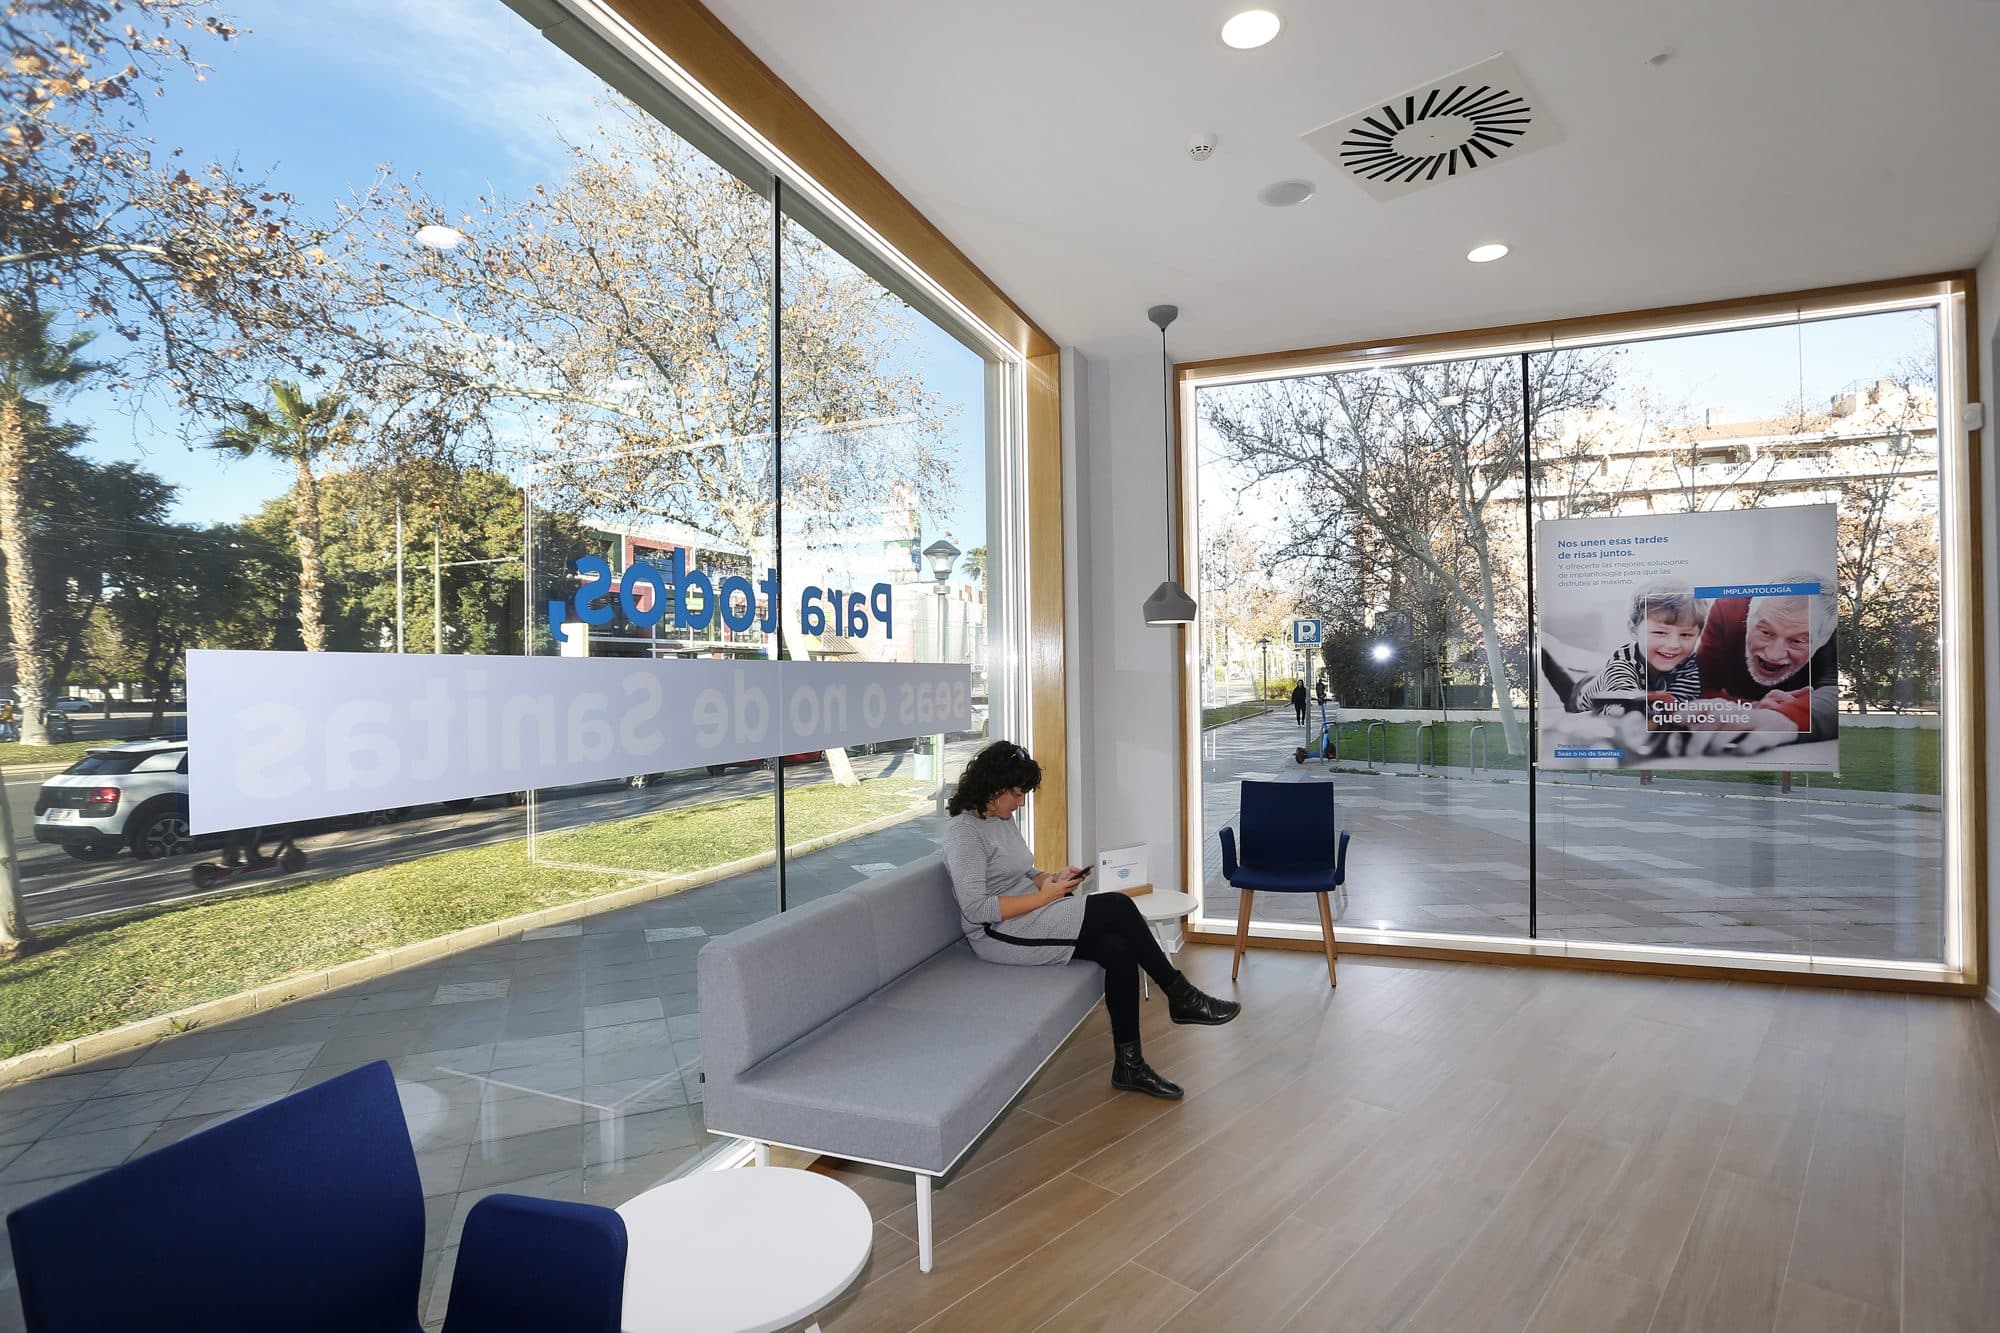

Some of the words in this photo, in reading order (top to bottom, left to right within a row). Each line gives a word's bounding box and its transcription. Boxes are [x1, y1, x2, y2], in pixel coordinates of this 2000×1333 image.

[1558, 540, 1578, 548] Nos
[1580, 539, 1606, 547] unen
[1609, 537, 1631, 545] esas
[1635, 536, 1669, 544] tardes
[1600, 549, 1635, 558] juntos.
[1566, 562, 1599, 570] ofrecerte
[1615, 560, 1645, 569] mejores
[1723, 586, 1791, 595] IMPLANTOLOGÍA
[1653, 700, 1732, 711] Cuidamos
[1738, 699, 1752, 711] lo
[1653, 714, 1682, 725] que
[1687, 714, 1715, 723] nos
[1720, 713, 1750, 723] une
